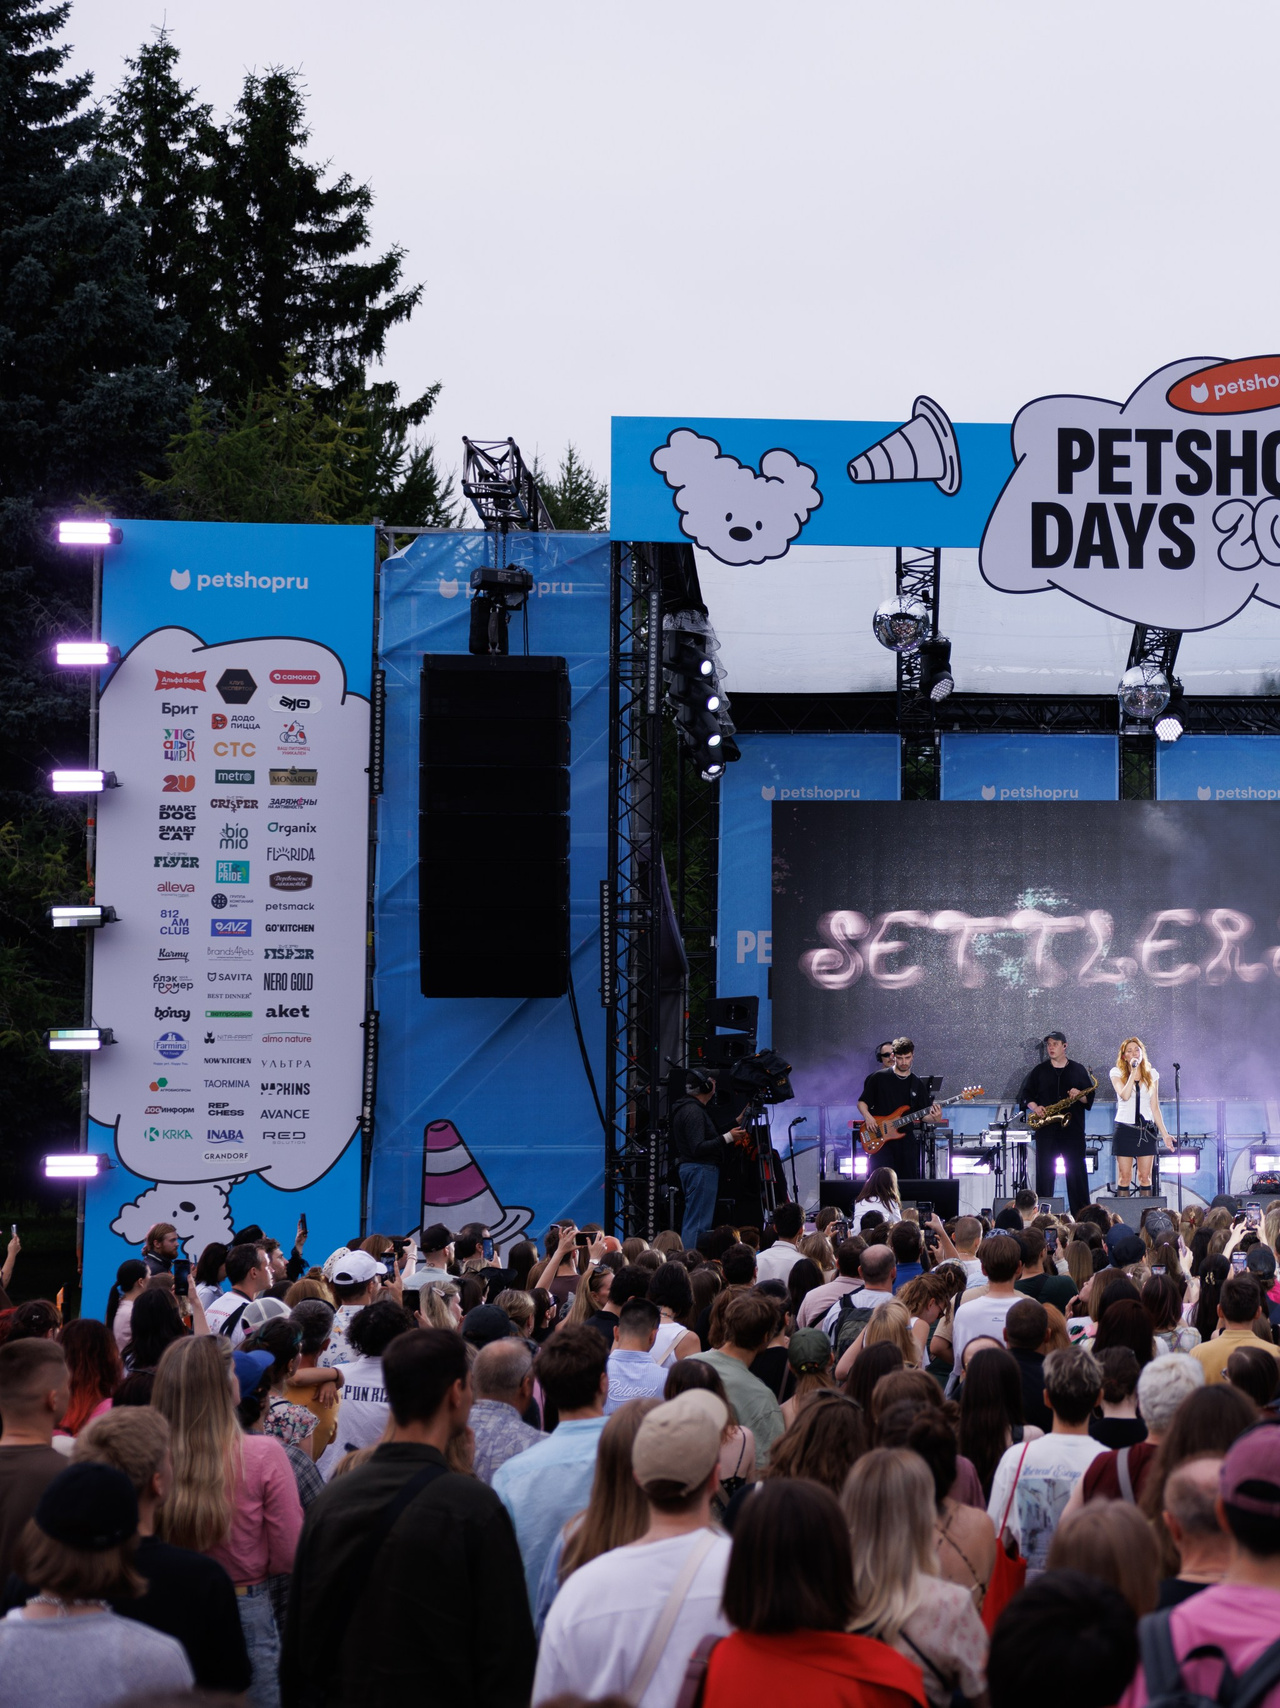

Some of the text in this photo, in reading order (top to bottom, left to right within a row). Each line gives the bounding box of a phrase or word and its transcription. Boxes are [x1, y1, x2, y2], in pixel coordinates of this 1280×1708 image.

[1031, 501, 1196, 570] DAYS
[197, 571, 309, 593] petshopru
[161, 676, 183, 685] Альфа
[162, 702, 198, 717] Брит
[213, 742, 256, 757] СТС
[218, 771, 252, 781] metro
[780, 785, 860, 800] petshopru
[1000, 785, 1078, 800] petshopru
[210, 799, 259, 812] CRISPER
[159, 812, 196, 820] DOG
[268, 822, 317, 836] Organix
[159, 833, 194, 841] CAT
[154, 856, 199, 868] FLYER
[218, 863, 233, 872] PET
[218, 872, 242, 882] PRIDE
[157, 881, 195, 893] alleva
[265, 903, 315, 911] petsmack
[160, 910, 179, 918] 812
[171, 918, 189, 927] AM
[222, 922, 249, 932] AVZ
[160, 926, 190, 935] CLUB
[158, 948, 189, 961] Karmy
[153, 974, 178, 982] блэк
[218, 973, 253, 981] SAVITA
[264, 973, 313, 991] NERO GOLD
[266, 1004, 310, 1018] aket
[262, 1035, 283, 1043] almo
[156, 1042, 187, 1050] Farmina
[261, 1060, 311, 1068] УЛЬТРА
[204, 1080, 250, 1088] TAORMINA
[260, 1109, 310, 1119] AVANCE
[163, 1130, 193, 1139] KRKA
[207, 1130, 244, 1140] INABA
[342, 1385, 369, 1402] PUN
[608, 1379, 658, 1401] Relaxed
